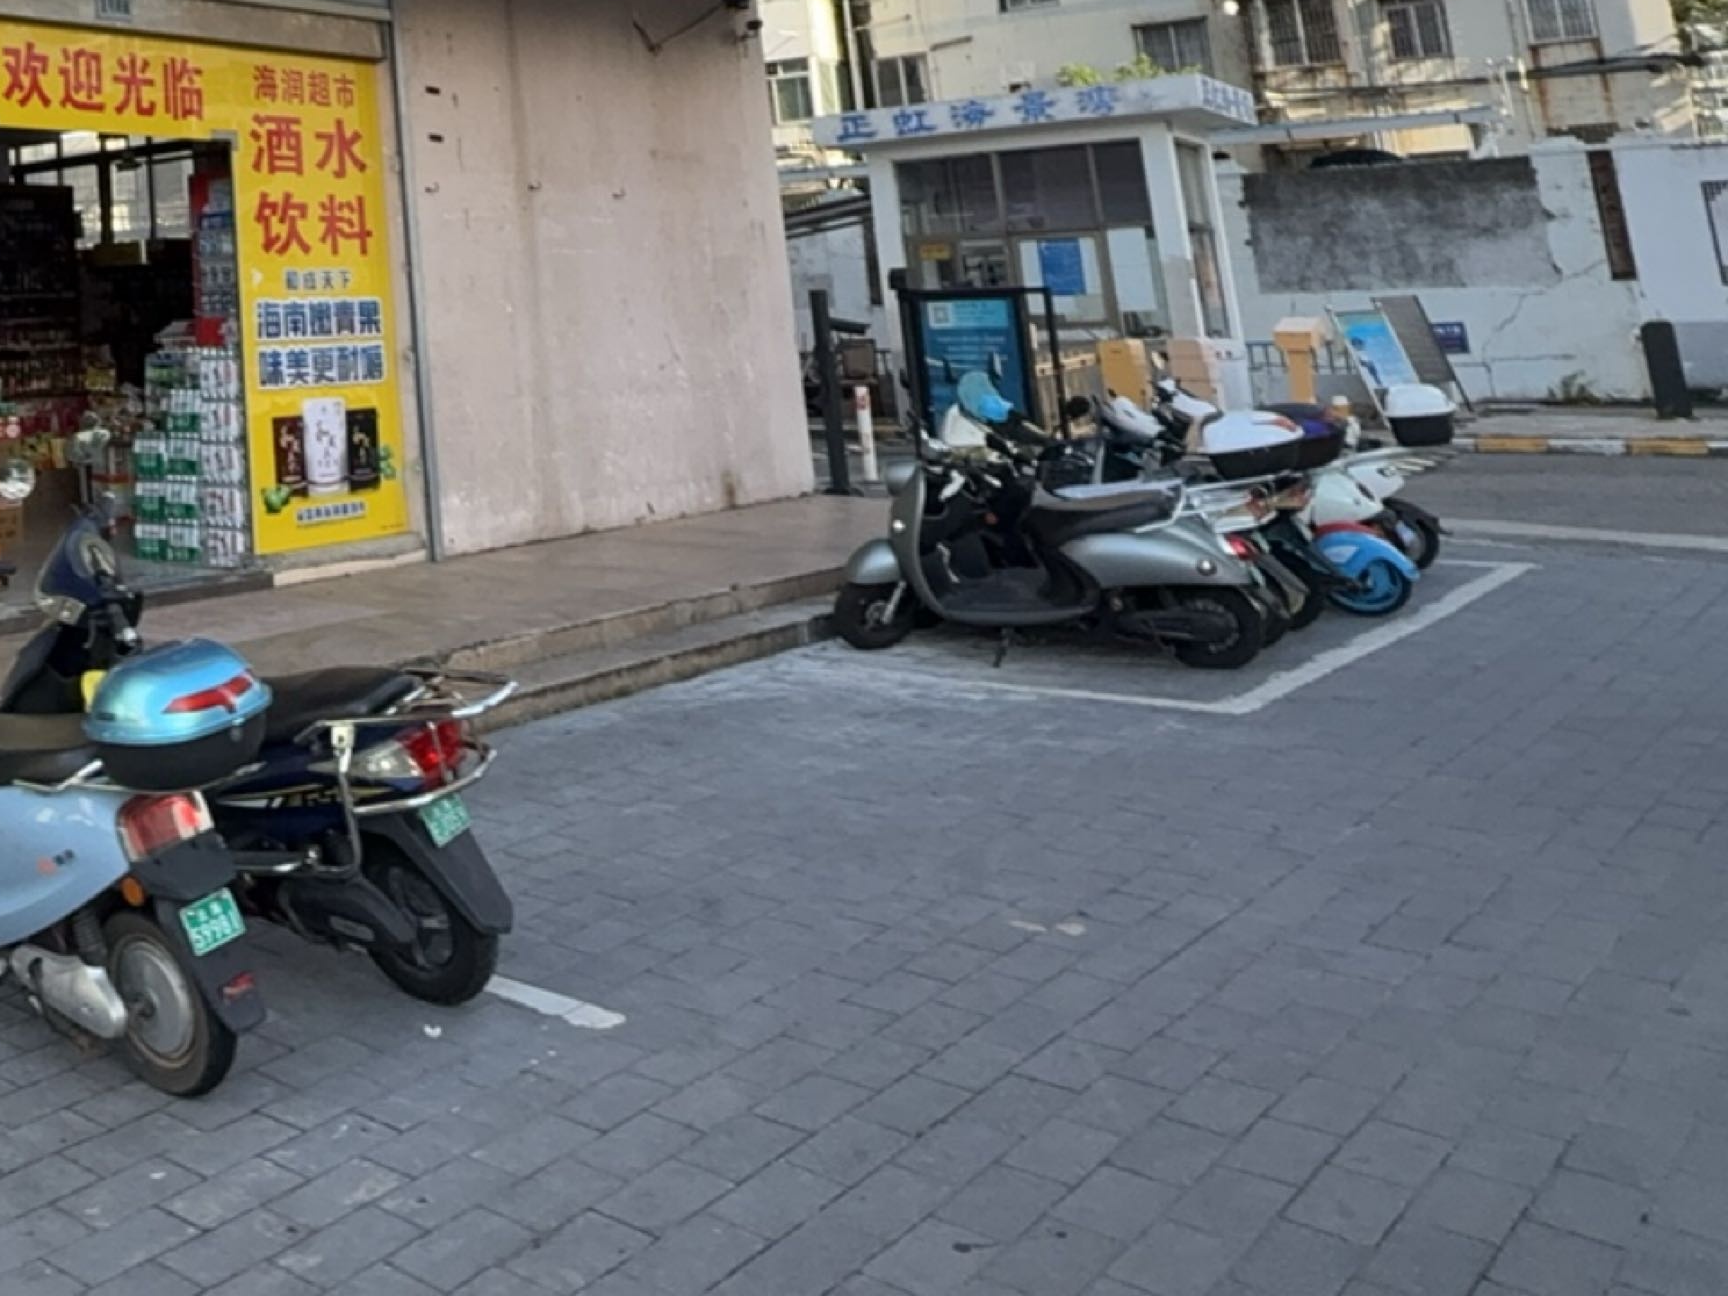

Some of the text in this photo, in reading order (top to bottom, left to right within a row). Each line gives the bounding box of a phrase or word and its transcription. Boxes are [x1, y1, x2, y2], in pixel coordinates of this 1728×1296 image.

[2, 40, 205, 122] 欢迎光临
[253, 64, 356, 109] 海润超市
[249, 112, 368, 179] 酒水
[253, 191, 374, 256] 饮料
